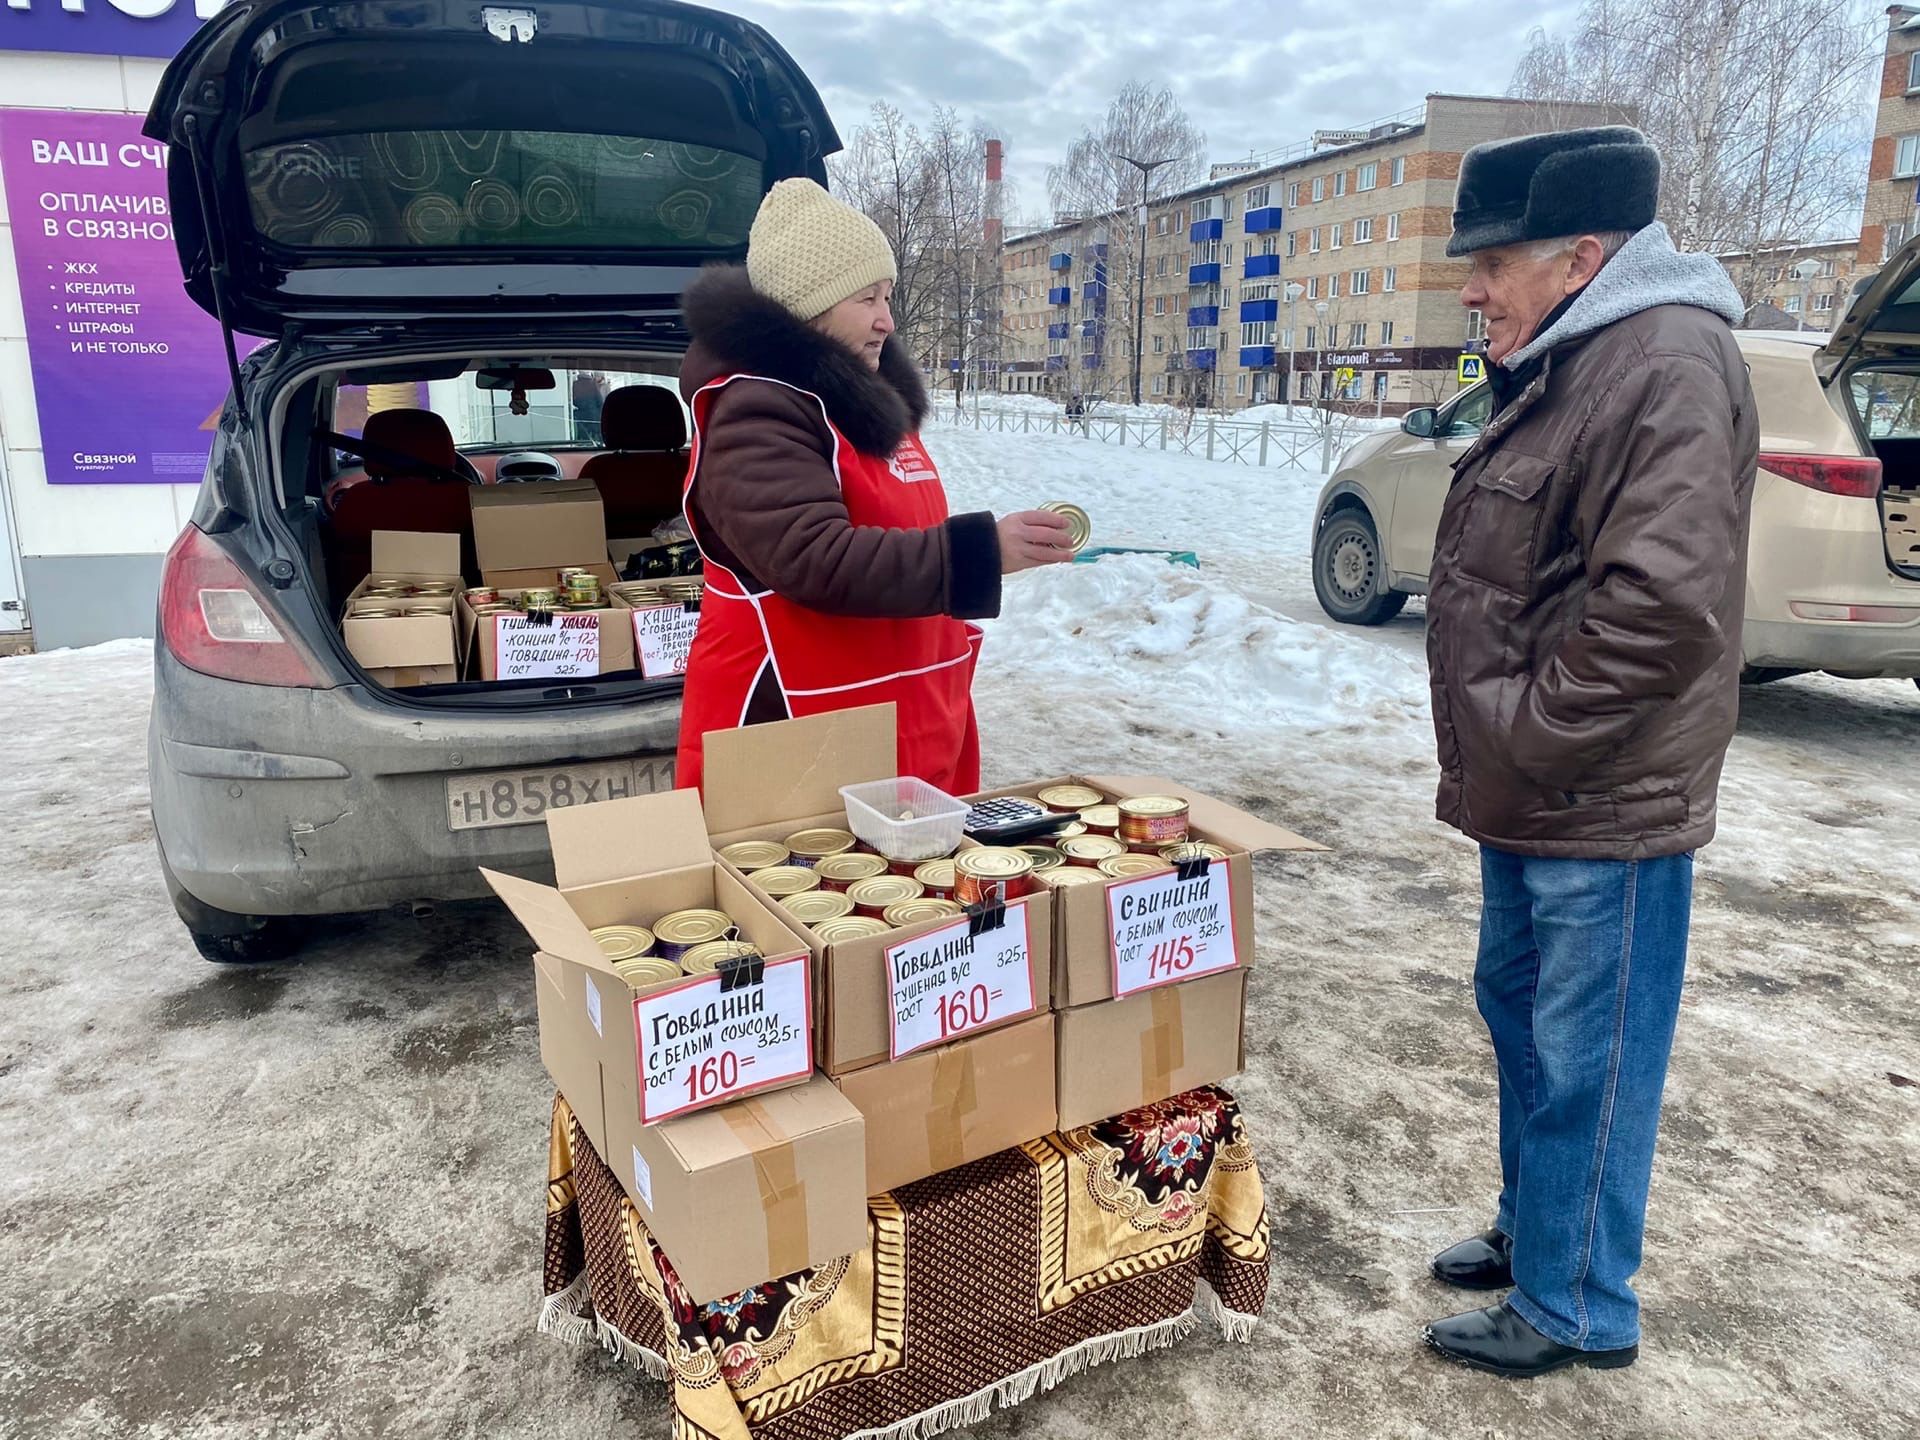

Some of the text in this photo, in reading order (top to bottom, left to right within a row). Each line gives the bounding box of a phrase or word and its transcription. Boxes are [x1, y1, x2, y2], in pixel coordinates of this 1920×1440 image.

[32, 139, 109, 166] ВАШ
[39, 192, 171, 215] ОПЛАЧИВ
[43, 218, 59, 237] В
[64, 262, 98, 274] ЖКХ
[64, 282, 135, 296] КРЕДИТЫ
[65, 302, 141, 314] ИНТЕРНЕТ
[68, 321, 134, 334] ШТРАФЫ
[71, 342, 169, 354] И НЕ ТОЛЬКО
[73, 452, 137, 464] Связной
[643, 607, 681, 626] КАША
[508, 633, 556, 646] КОНИНА
[507, 665, 532, 674] ГОСТ
[1126, 916, 1165, 943] БЕЛЫМ
[1172, 903, 1218, 929] СОУСОМ
[1199, 920, 1225, 939] 325г
[996, 944, 1027, 968] 325г
[1119, 943, 1144, 964] ГОСТ
[894, 970, 947, 1006] ТУШЕНАЯ
[897, 998, 924, 1025] ГОСТ
[665, 1032, 713, 1066] БЕЛЫМ
[720, 1013, 779, 1042] СОУСОМ
[757, 1024, 800, 1048] 325г
[644, 1068, 676, 1091] ГОСТ
